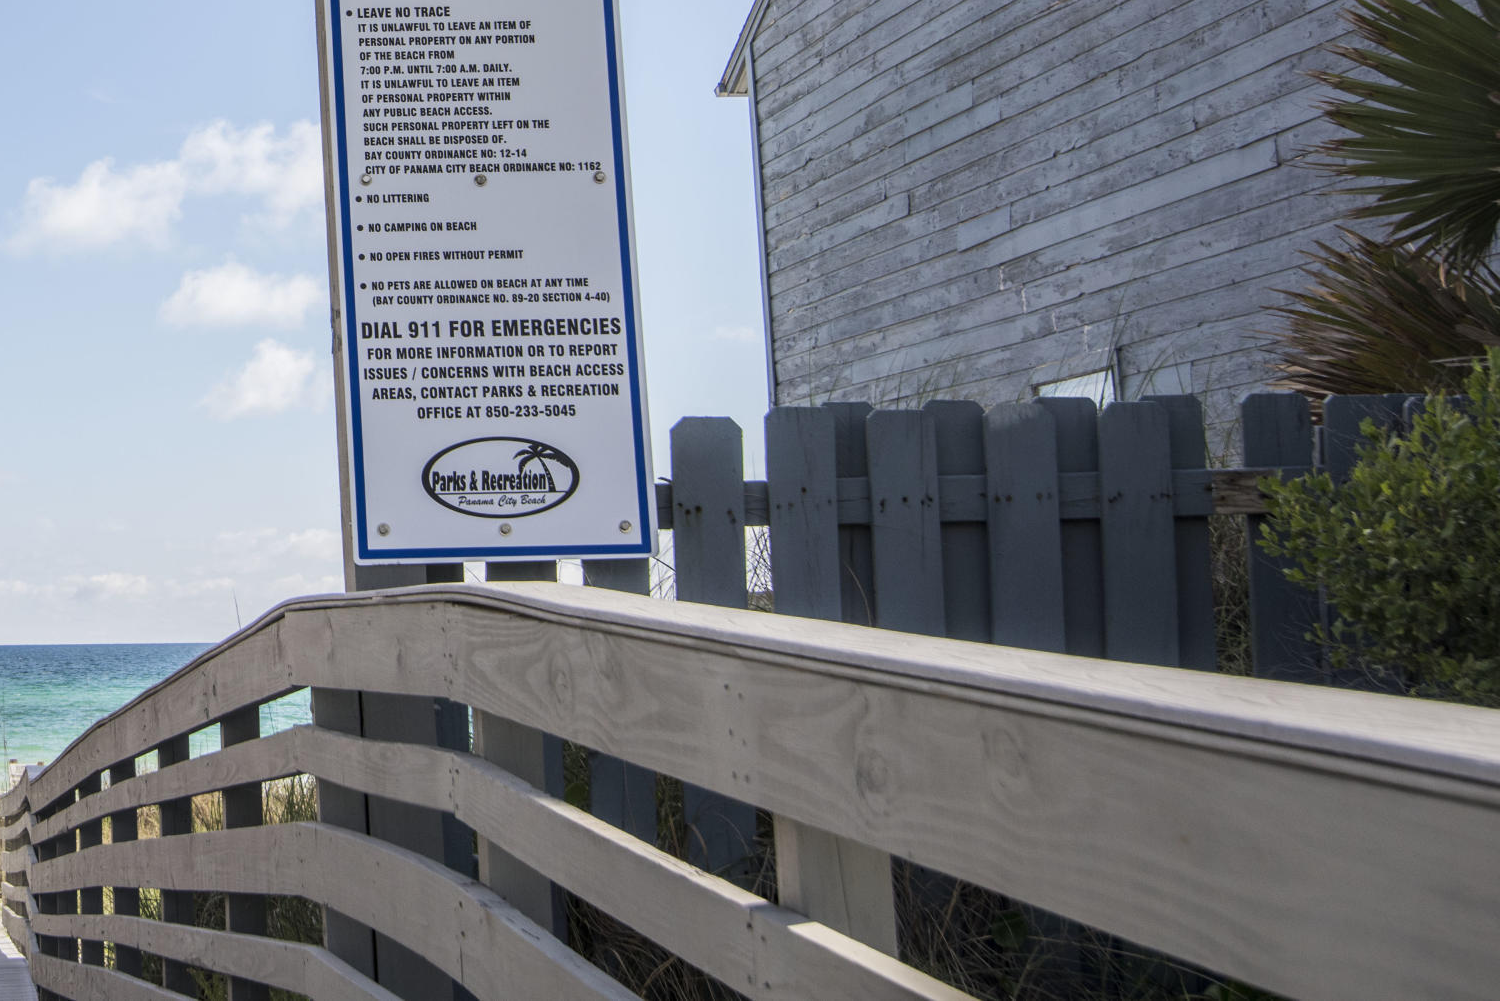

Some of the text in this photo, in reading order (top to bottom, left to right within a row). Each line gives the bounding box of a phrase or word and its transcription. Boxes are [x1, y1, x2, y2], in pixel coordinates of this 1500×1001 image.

[356, 6, 450, 19] LEAVE NO TRACE
[357, 21, 532, 33] IT IS UNLAWFUL TO LEAVE AN ITEM OF
[359, 64, 512, 75] 7:00 P.M. UNTIL 7:00 A.M. DAILY.
[365, 162, 601, 175] CITY OF PANAMA CITY BEACH ORDINANCE NO: 1162
[365, 194, 430, 204] NO LITTERING
[372, 292, 610, 307] (BAY COUNTY ORDINANCE NO. 89-20 SECTION 4-40)
[360, 317, 621, 339] DIAL 911 FOR EMERGENCIES
[366, 344, 618, 360] FOR MORE INFORMATION OR TO REPORT
[363, 364, 624, 381] ISSUES / CONCERNS WITH BEACH ACCESS
[372, 384, 619, 401] AREAS, CONTACT PARKS & RECREATION
[416, 404, 577, 419] OFFICE AT 850-233-5045
[432, 470, 547, 493] Parks & Recreation
[457, 494, 546, 508] Panama City Beach
